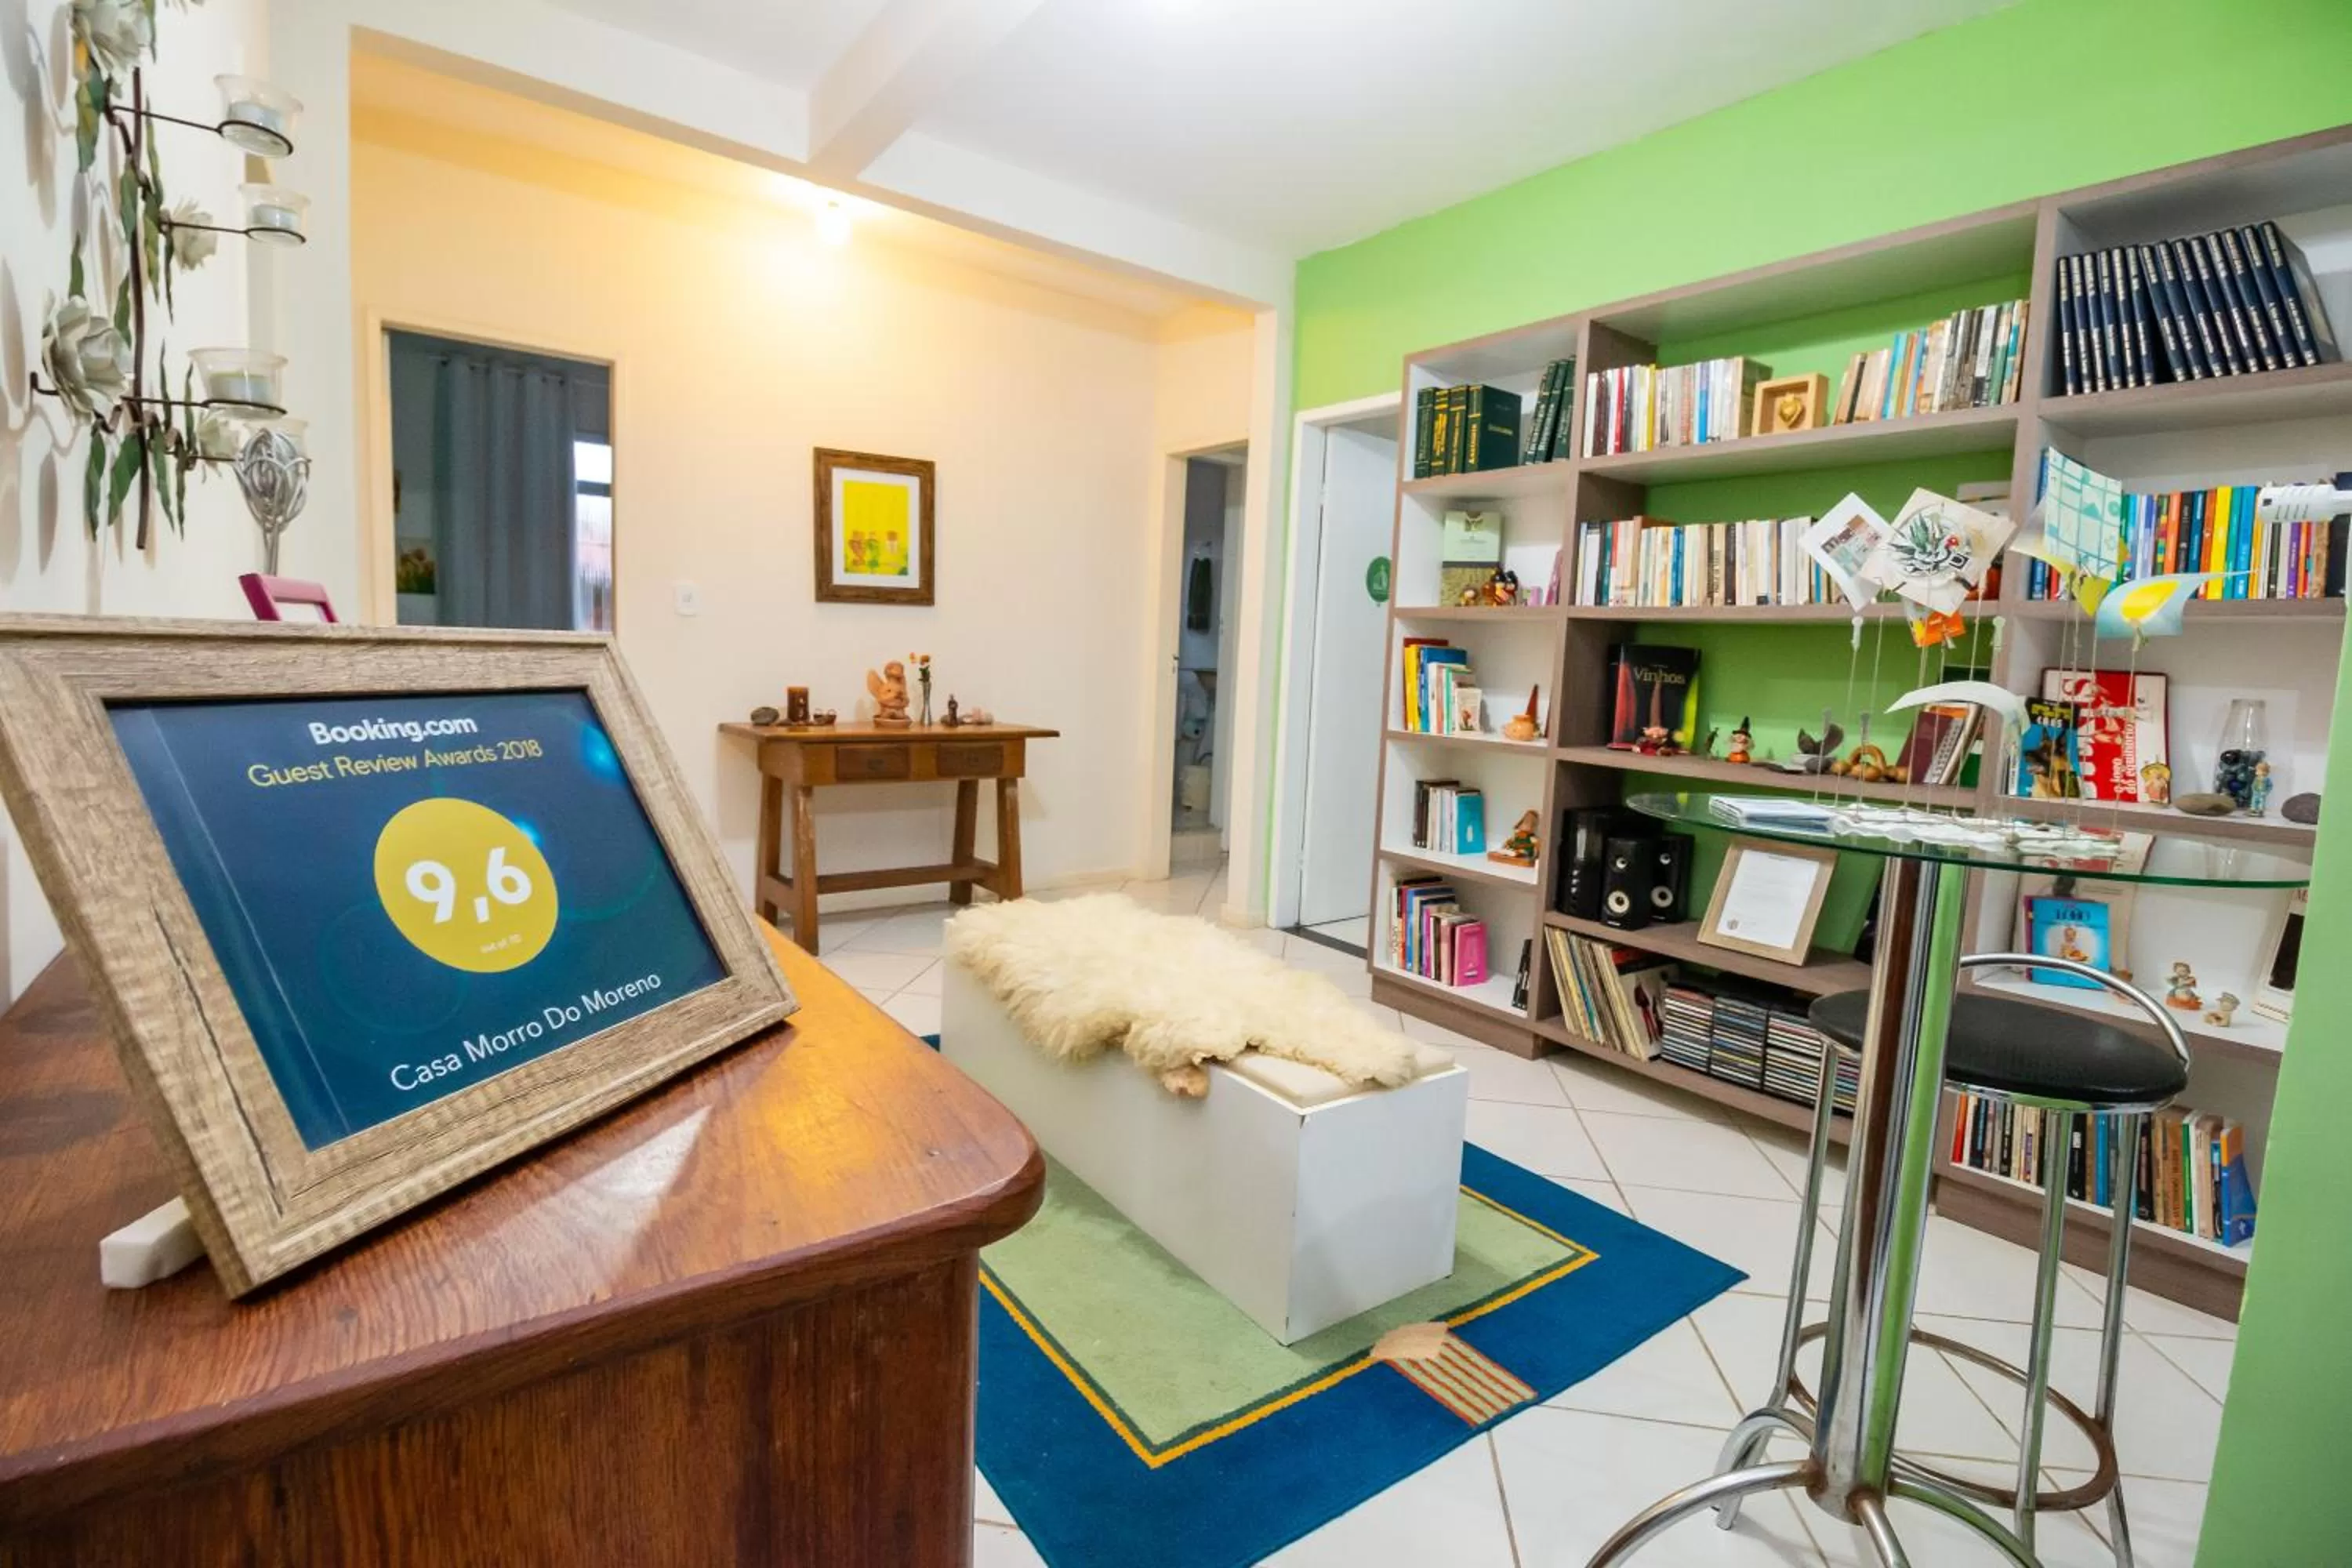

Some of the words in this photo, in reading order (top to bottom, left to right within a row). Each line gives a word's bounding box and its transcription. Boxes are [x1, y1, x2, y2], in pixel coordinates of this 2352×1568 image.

[1633, 666, 1686, 684] Vinhos
[308, 716, 479, 746] Booking.com
[248, 757, 334, 787] Guest
[336, 753, 419, 778] Review
[423, 743, 497, 768] Awards
[497, 739, 543, 760] 2018
[405, 846, 532, 924] 9,6
[390, 1054, 462, 1091] Casa
[463, 1022, 543, 1062] Morro
[543, 1006, 581, 1029] Do
[581, 975, 662, 1014] Moreno
